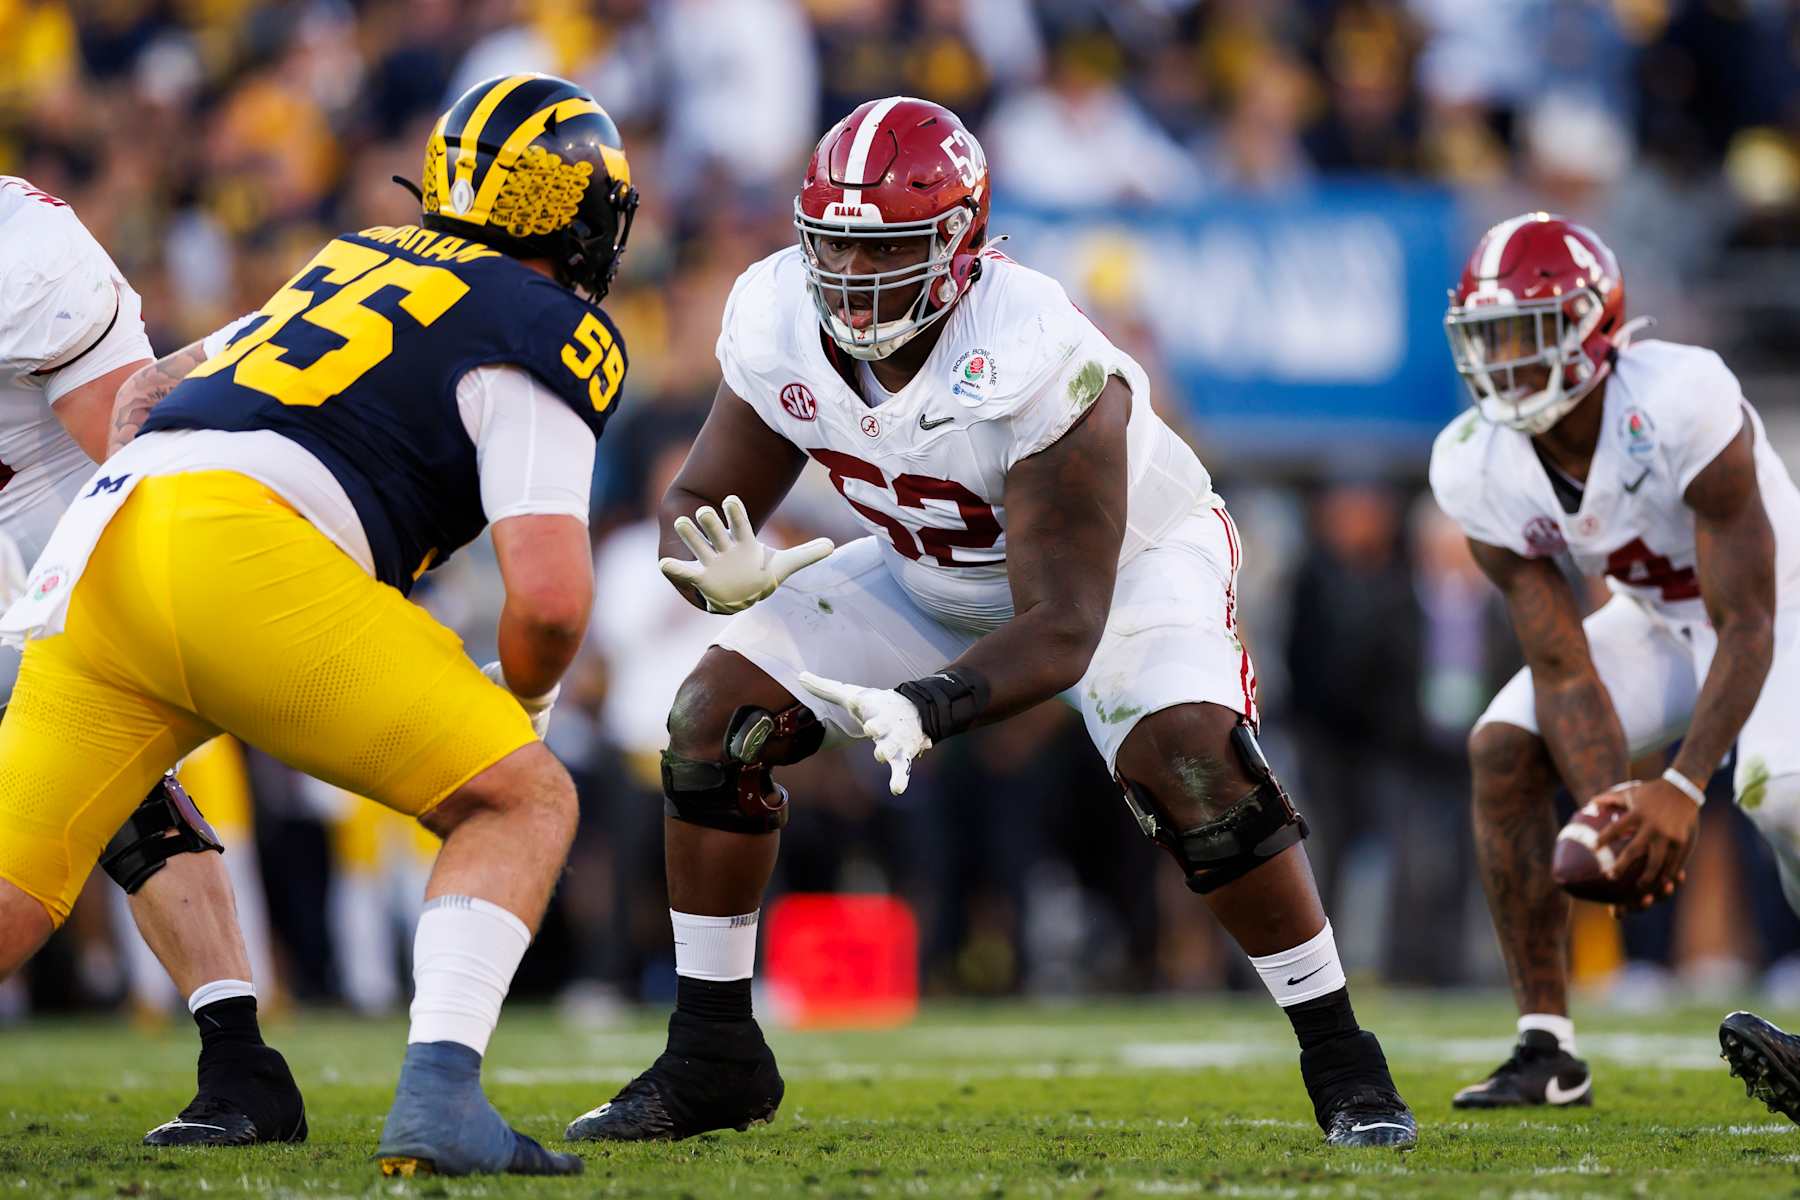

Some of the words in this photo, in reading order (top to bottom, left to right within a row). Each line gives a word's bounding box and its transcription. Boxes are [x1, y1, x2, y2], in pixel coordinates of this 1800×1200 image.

[939, 129, 985, 189] 52
[834, 206, 863, 216] BAMA
[1563, 234, 1604, 283] 4
[184, 239, 471, 407] 55
[989, 358, 998, 386] GAME
[781, 383, 816, 420] SEC
[862, 417, 878, 435] A
[84, 473, 133, 499] M
[805, 447, 1008, 567] 52
[1604, 537, 1702, 602] 4
